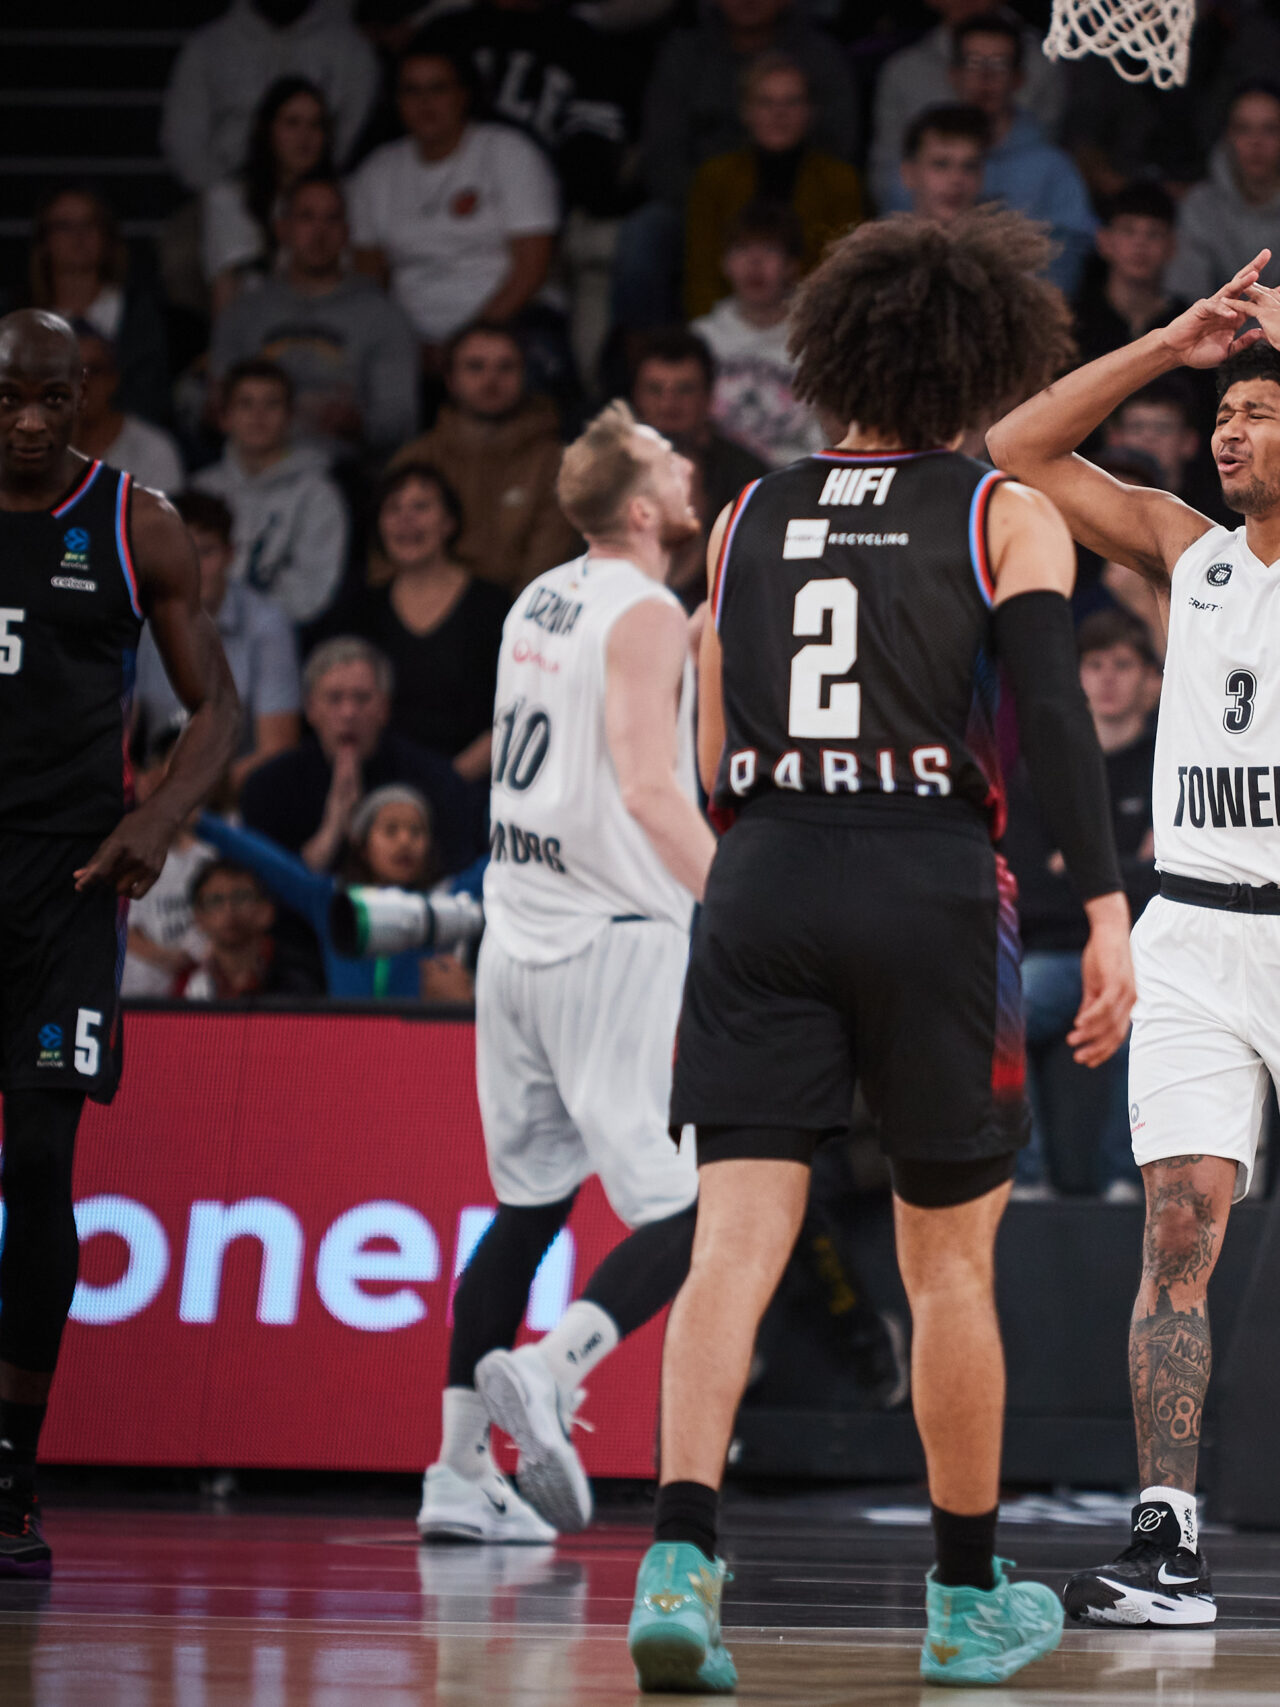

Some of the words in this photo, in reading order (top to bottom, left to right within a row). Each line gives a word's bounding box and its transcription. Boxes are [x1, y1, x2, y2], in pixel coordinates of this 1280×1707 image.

[818, 467, 898, 505] HIFI
[828, 532, 909, 546] RECYCLING
[788, 577, 861, 739] 2
[1223, 669, 1257, 734] 3
[493, 702, 550, 791] 10
[729, 746, 951, 797] PARIS
[74, 1008, 103, 1076] 5
